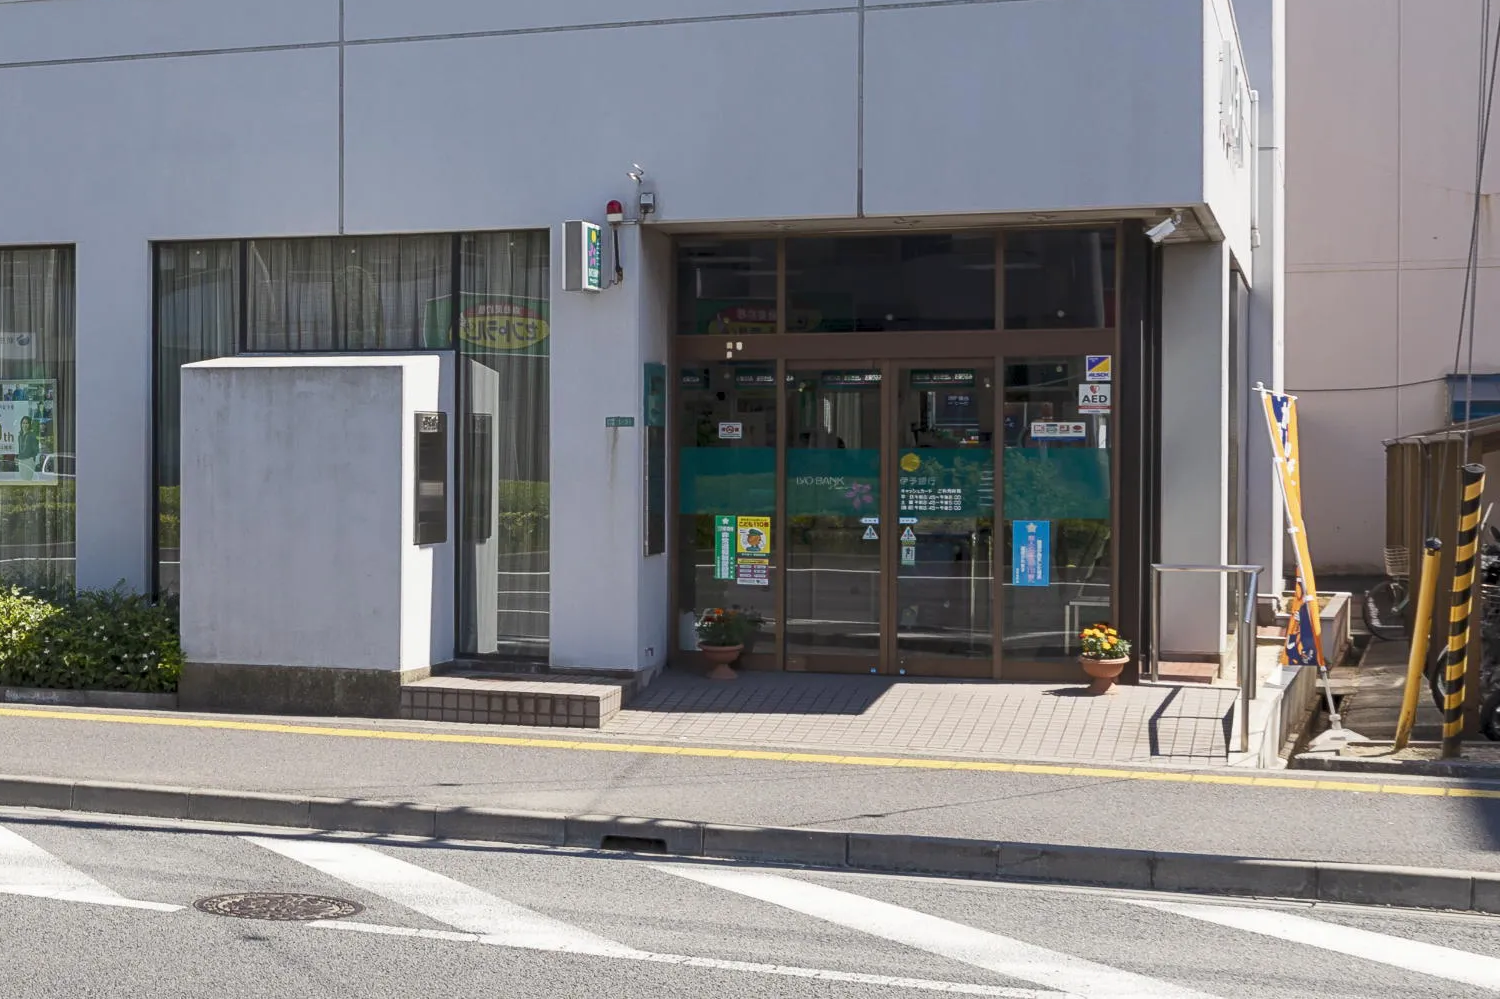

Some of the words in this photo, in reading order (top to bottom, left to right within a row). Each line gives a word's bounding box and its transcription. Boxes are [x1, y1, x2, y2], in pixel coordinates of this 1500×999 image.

[1082, 394, 1108, 403] AED
[797, 477, 813, 486] IYO
[815, 477, 845, 487] BANK
[900, 477, 937, 487] 伊予銀行
